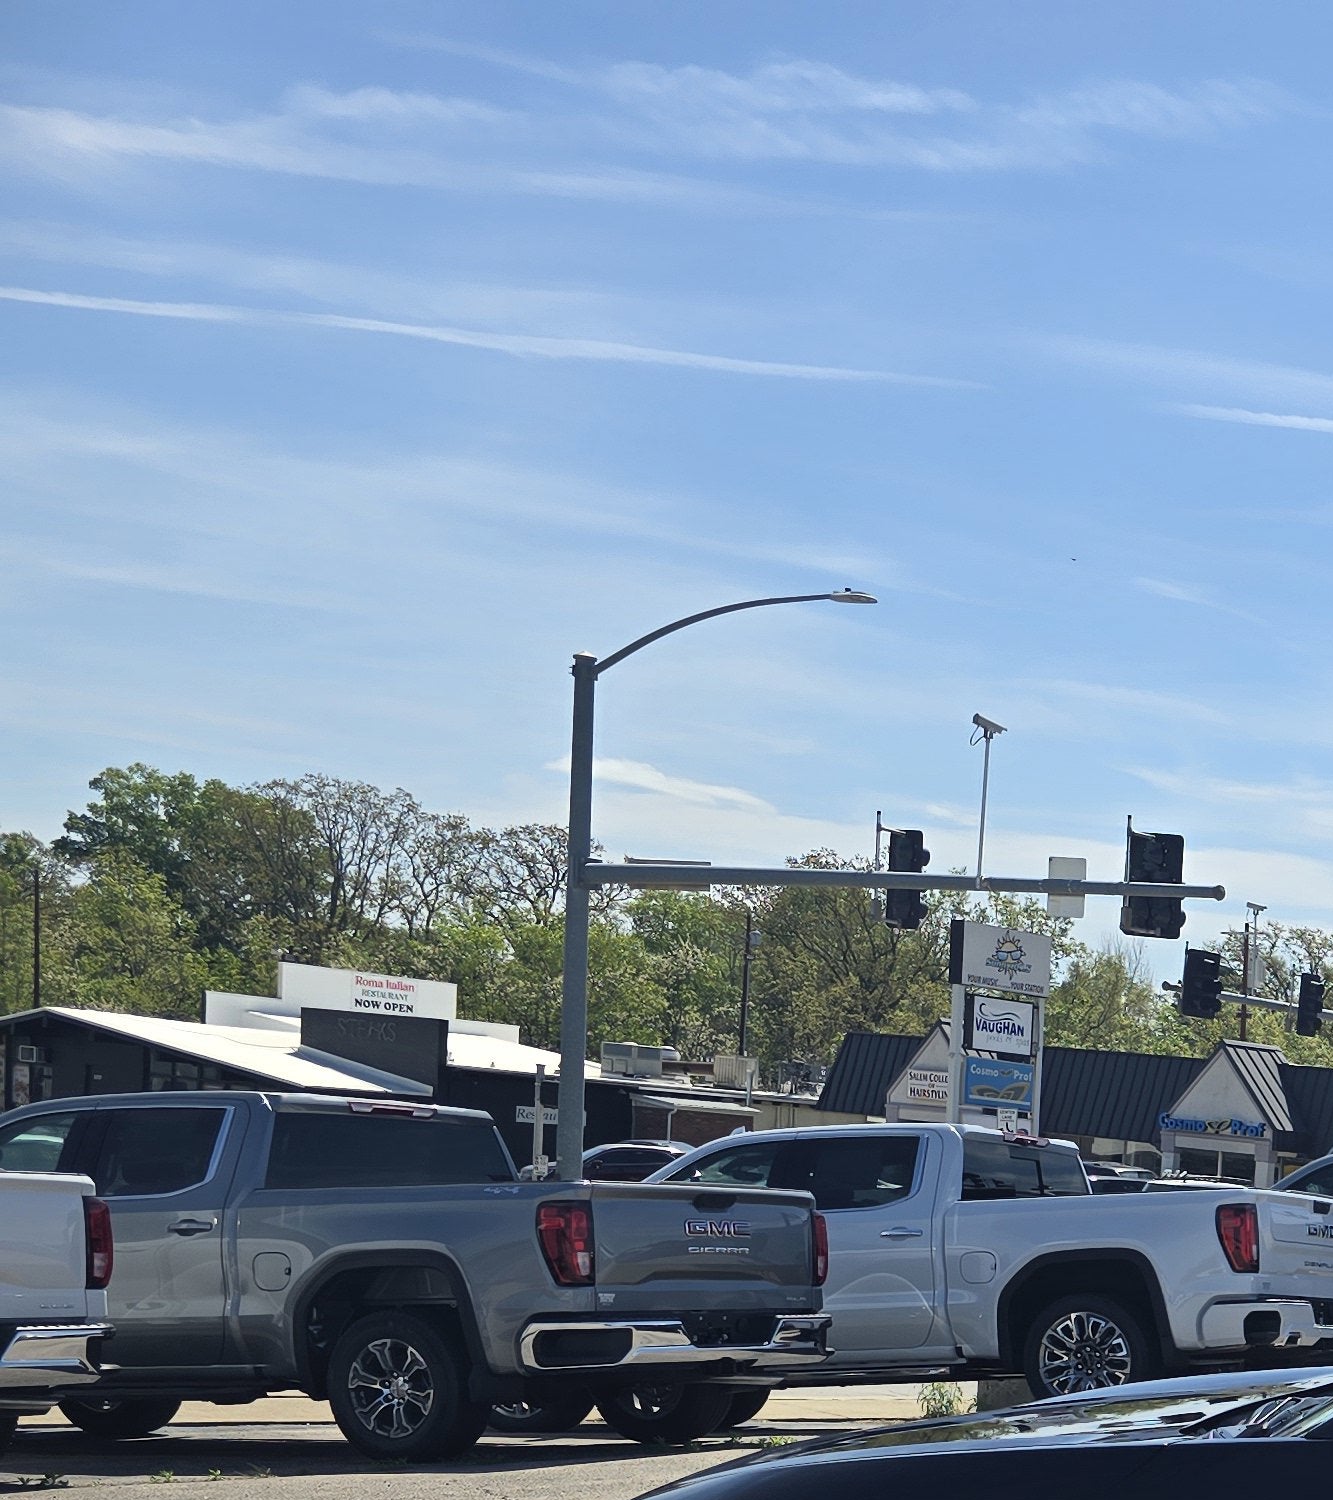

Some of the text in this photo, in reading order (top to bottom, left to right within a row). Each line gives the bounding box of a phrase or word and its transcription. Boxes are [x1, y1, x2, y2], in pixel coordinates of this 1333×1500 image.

[355, 975, 415, 992] Roma Italian
[967, 974, 982, 984] YOUR
[1010, 981, 1024, 990] YOUR
[1024, 983, 1045, 994] STATION
[361, 988, 409, 1001] RESTAURANT
[354, 998, 415, 1013] NOW OPEN
[975, 1016, 1025, 1037] VAUGHAN
[909, 1070, 949, 1083] SALEM COLLE
[970, 1064, 1033, 1082] Cosmo Prof
[909, 1087, 948, 1099] HAIRSTYLIN
[1160, 1112, 1266, 1138] Cosmo Prof
[684, 1219, 751, 1238] GMC
[688, 1246, 750, 1255] SIERRA
[1304, 1260, 1333, 1269] DENALI
